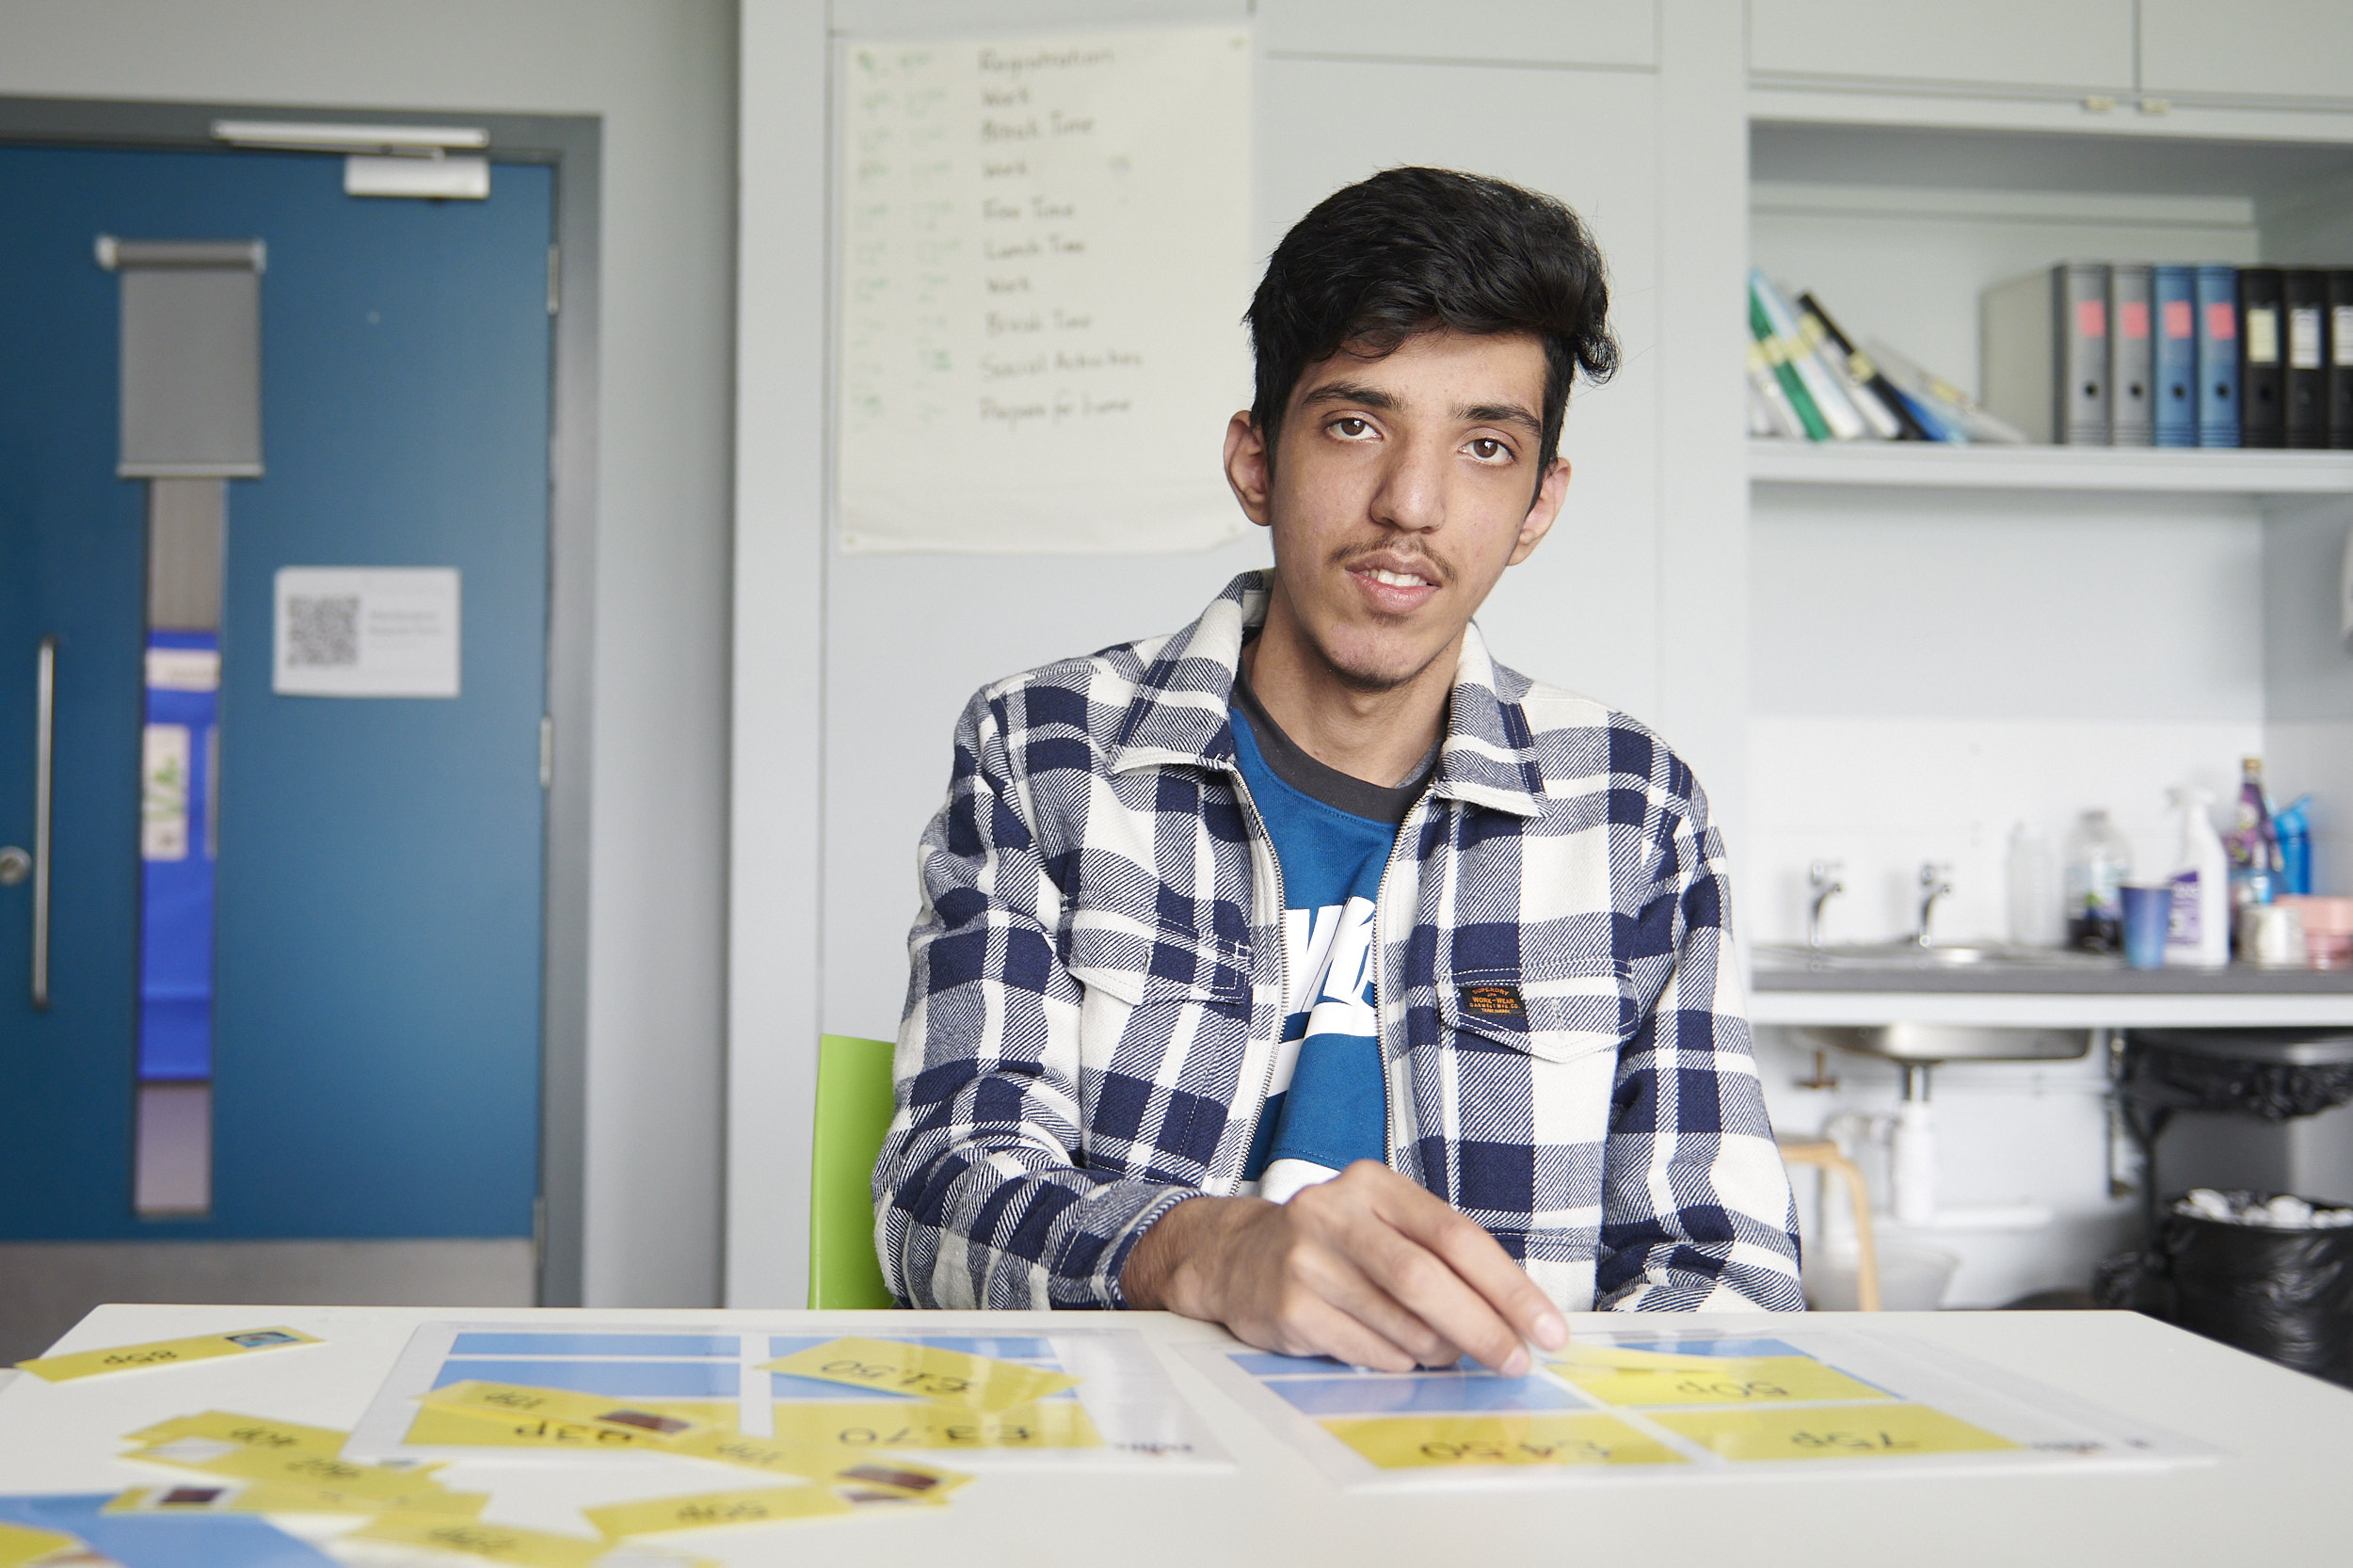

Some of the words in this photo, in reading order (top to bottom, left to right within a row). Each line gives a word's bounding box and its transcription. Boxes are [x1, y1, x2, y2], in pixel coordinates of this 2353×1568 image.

[1472, 987, 1509, 996] SUPERDRY
[821, 1360, 971, 1395] £1.50
[839, 1424, 1031, 1446] £3.70
[1791, 1431, 1921, 1451] 75p
